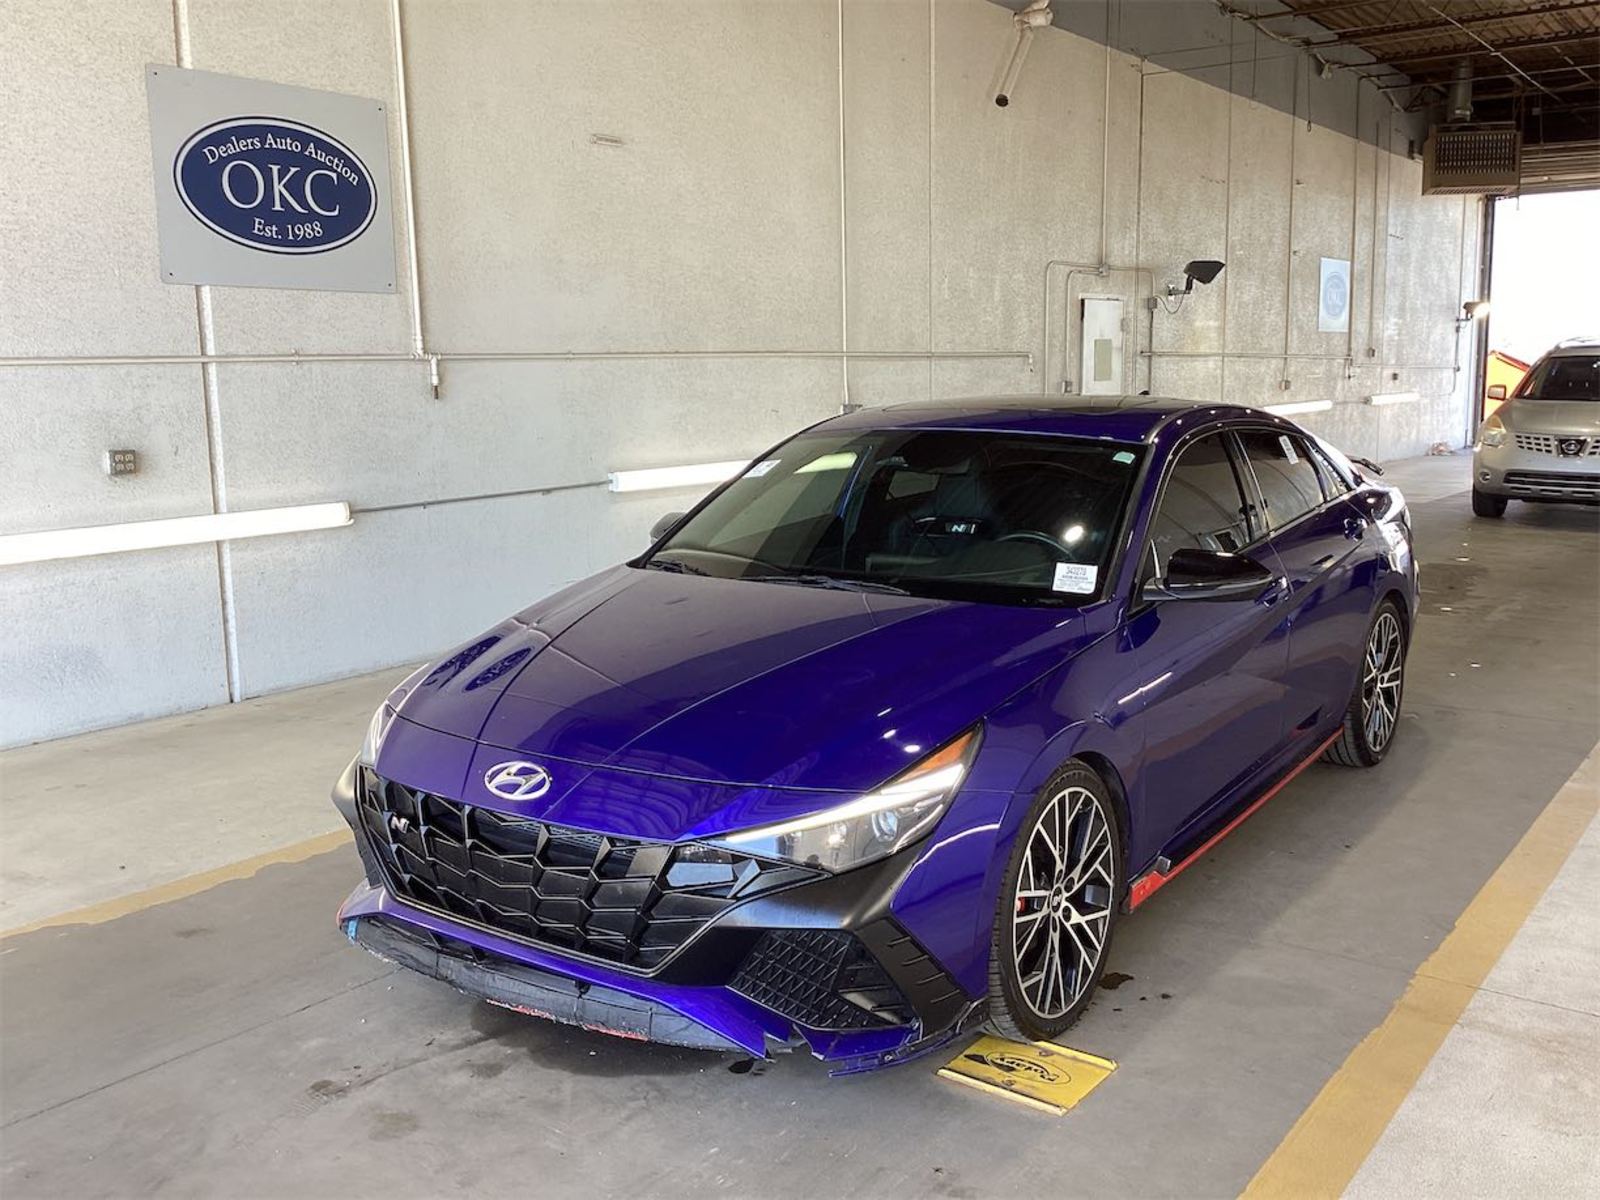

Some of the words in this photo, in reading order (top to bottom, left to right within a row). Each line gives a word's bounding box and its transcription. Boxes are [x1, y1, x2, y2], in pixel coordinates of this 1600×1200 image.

[202, 135, 261, 165] Dealers
[264, 132, 301, 153] Auto
[304, 142, 359, 187] Auction
[221, 160, 340, 217] OKC
[252, 217, 282, 240] Est.
[287, 220, 323, 241] 1988
